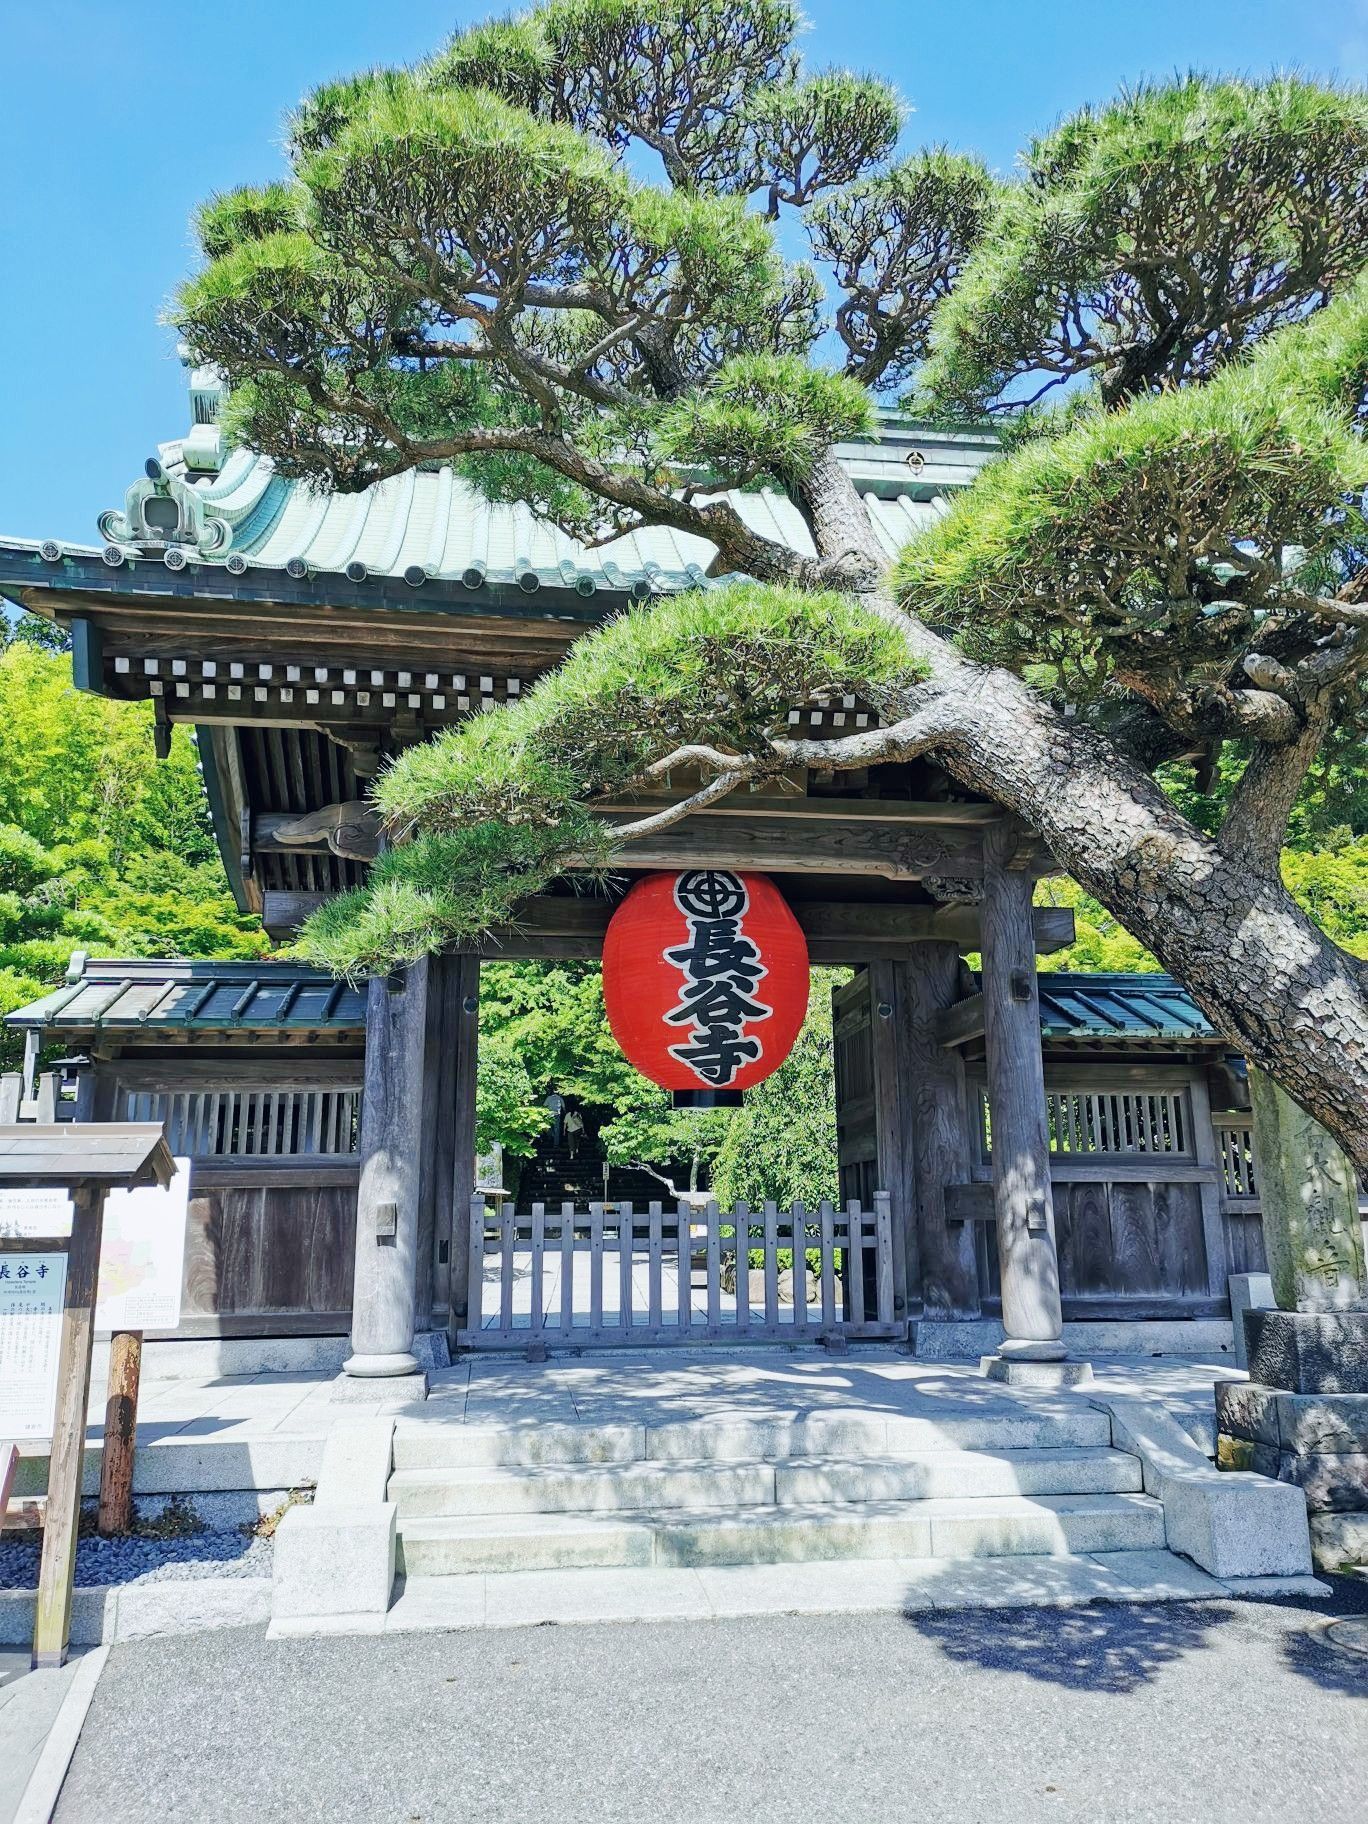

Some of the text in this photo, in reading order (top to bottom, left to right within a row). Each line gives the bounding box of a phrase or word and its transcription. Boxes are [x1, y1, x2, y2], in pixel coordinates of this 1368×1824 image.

[665, 918, 772, 1086] 長谷寺
[0, 1264, 50, 1279] 長谷寺
